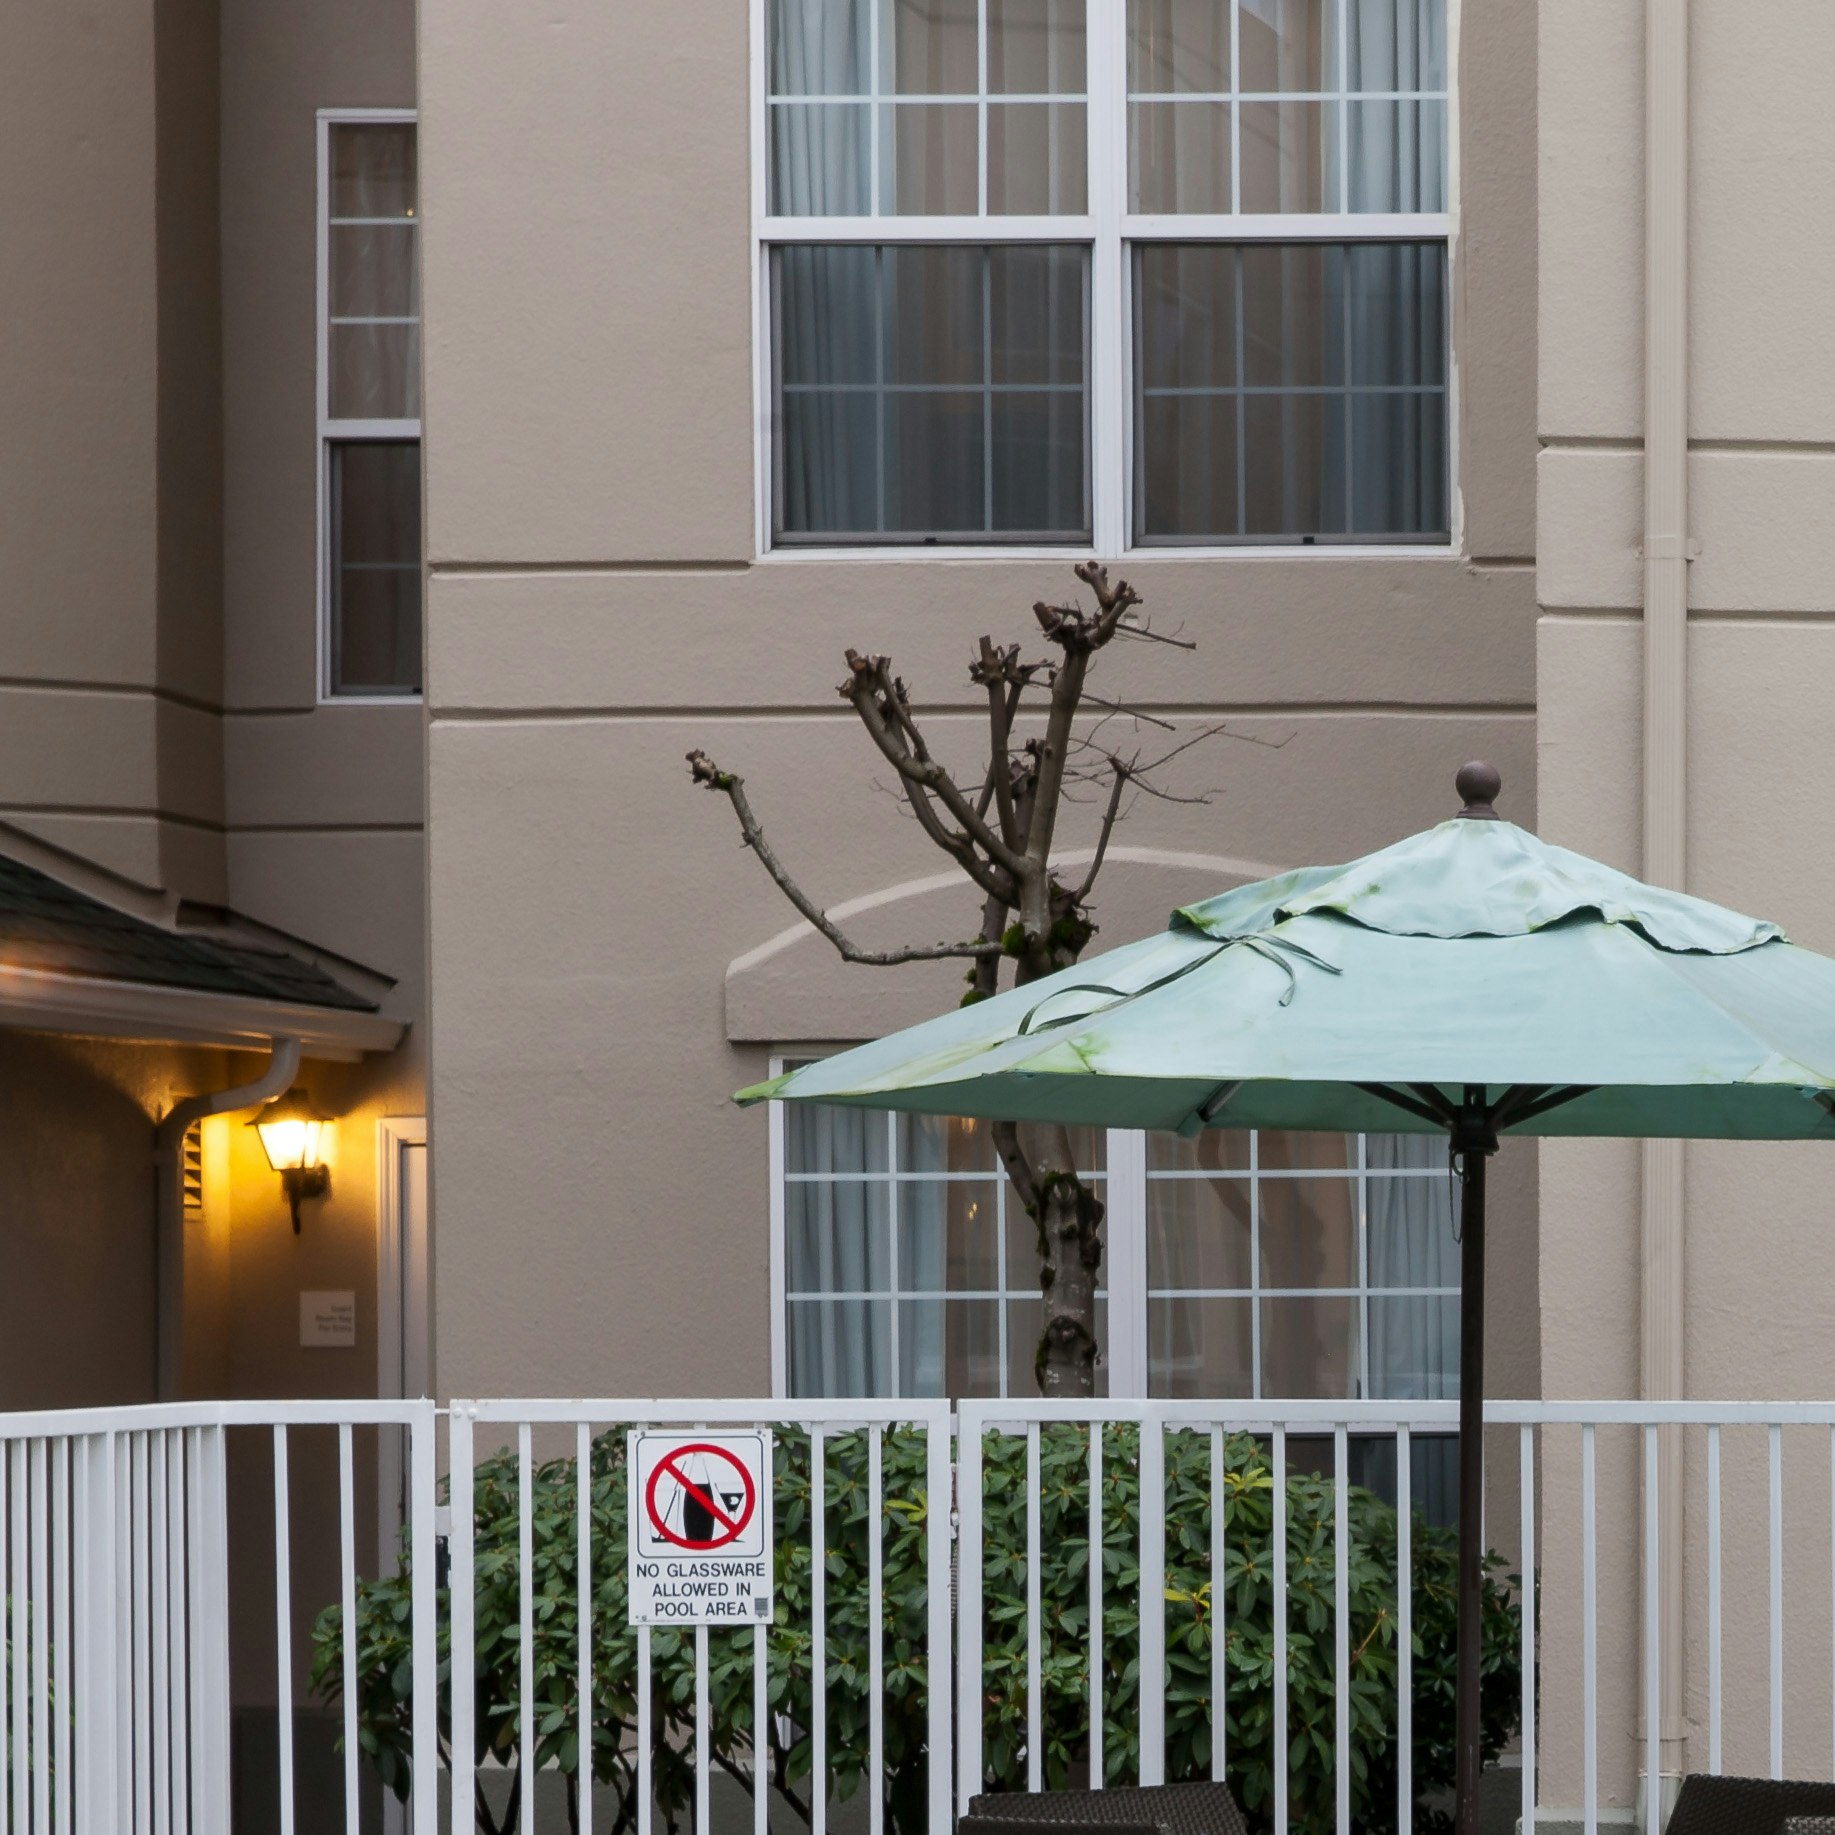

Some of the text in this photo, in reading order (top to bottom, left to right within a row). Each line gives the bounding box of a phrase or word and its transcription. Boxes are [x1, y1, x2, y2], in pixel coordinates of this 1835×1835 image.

[636, 1562, 766, 1578] NO GLASSWARE
[652, 1582, 751, 1597] ALLOWED IN
[655, 1601, 748, 1617] POOL AREA
